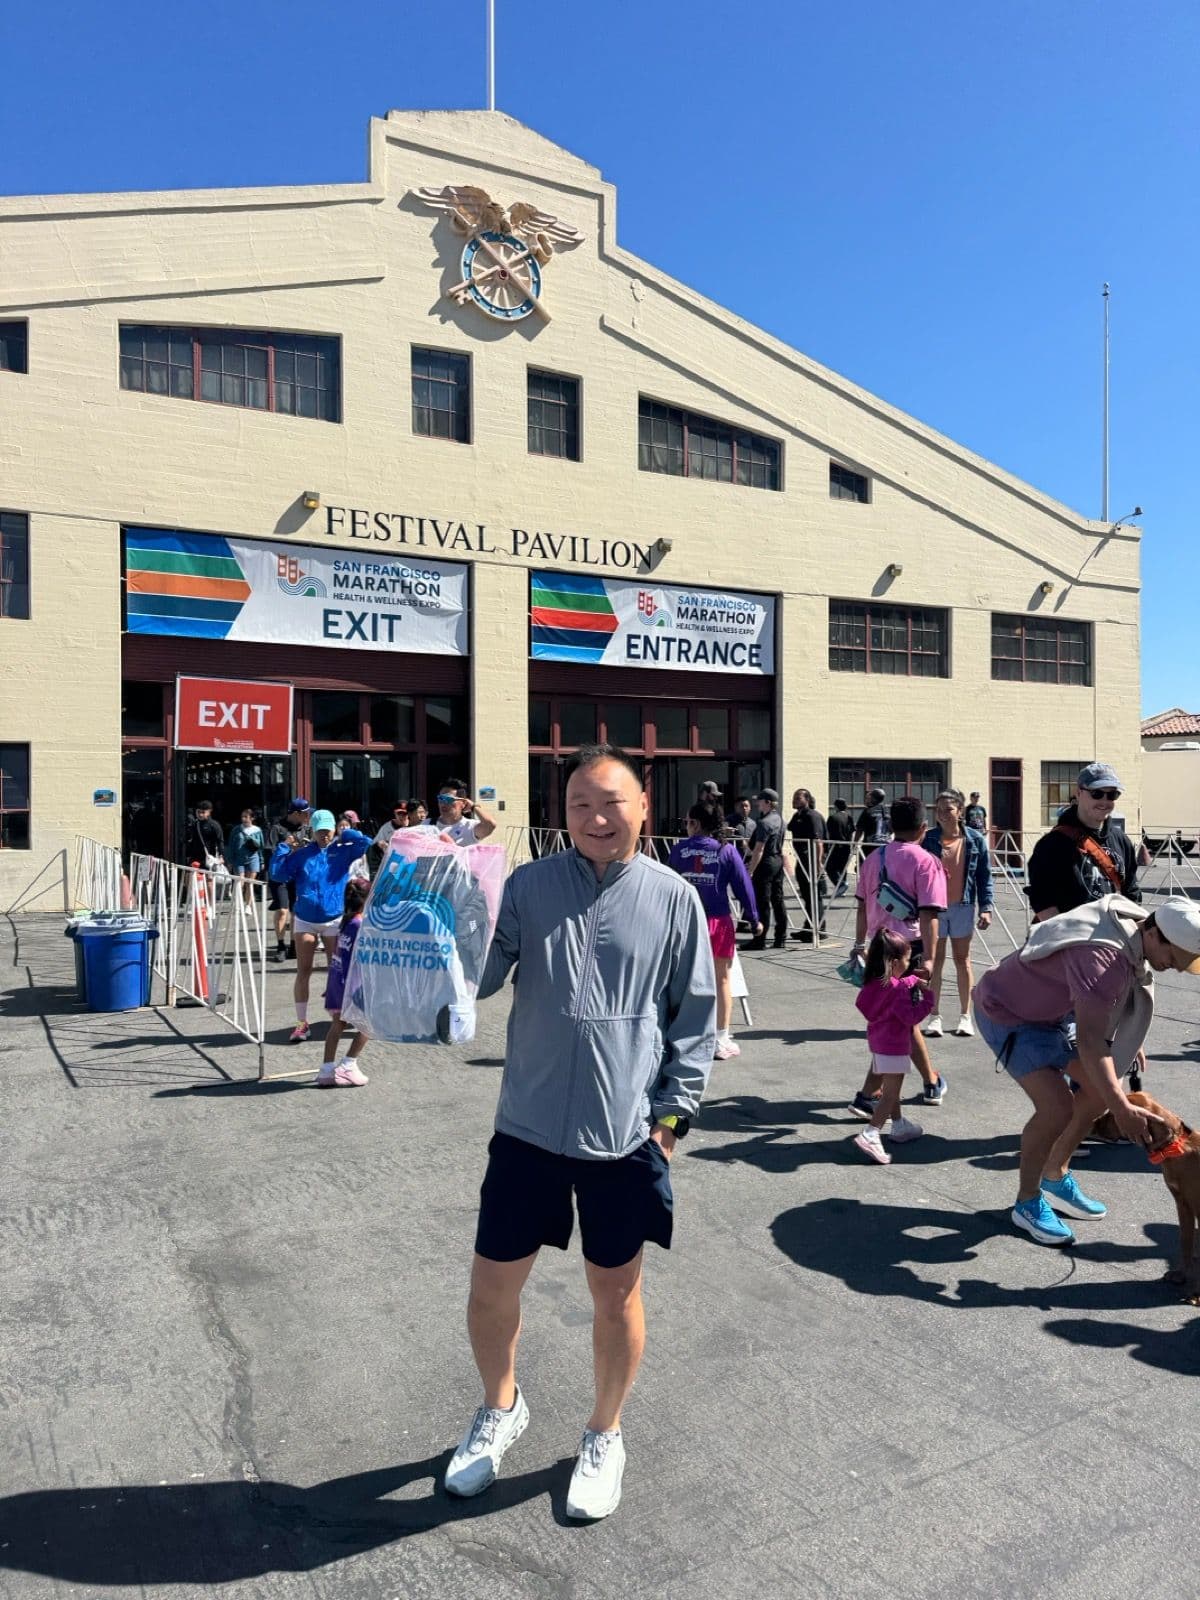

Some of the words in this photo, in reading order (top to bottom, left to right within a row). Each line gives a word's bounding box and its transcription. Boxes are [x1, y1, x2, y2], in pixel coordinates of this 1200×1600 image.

[324, 505, 496, 553] FESTIVAL
[510, 529, 652, 569] PAVILION
[333, 560, 360, 573] SAN
[365, 564, 440, 581] FRANCISCO
[333, 573, 440, 597] MARATHON
[333, 592, 365, 603] HEALTH
[366, 595, 373, 603] &
[374, 596, 417, 608] WELLNESS
[419, 600, 440, 609] EXPO
[678, 595, 698, 607] SAN
[701, 597, 756, 612] FRANCISCO
[323, 609, 402, 643] EXIT
[676, 606, 756, 625] MARATHON
[676, 622, 699, 631] HEALTH
[706, 626, 737, 634] WELLNESS
[739, 628, 754, 636] EXPO
[626, 633, 762, 668] ENTRANCE
[198, 700, 271, 730] EXIT
[359, 936, 379, 947] SAN
[382, 938, 452, 955] FRANCISCO
[357, 949, 449, 971] MARATHON
